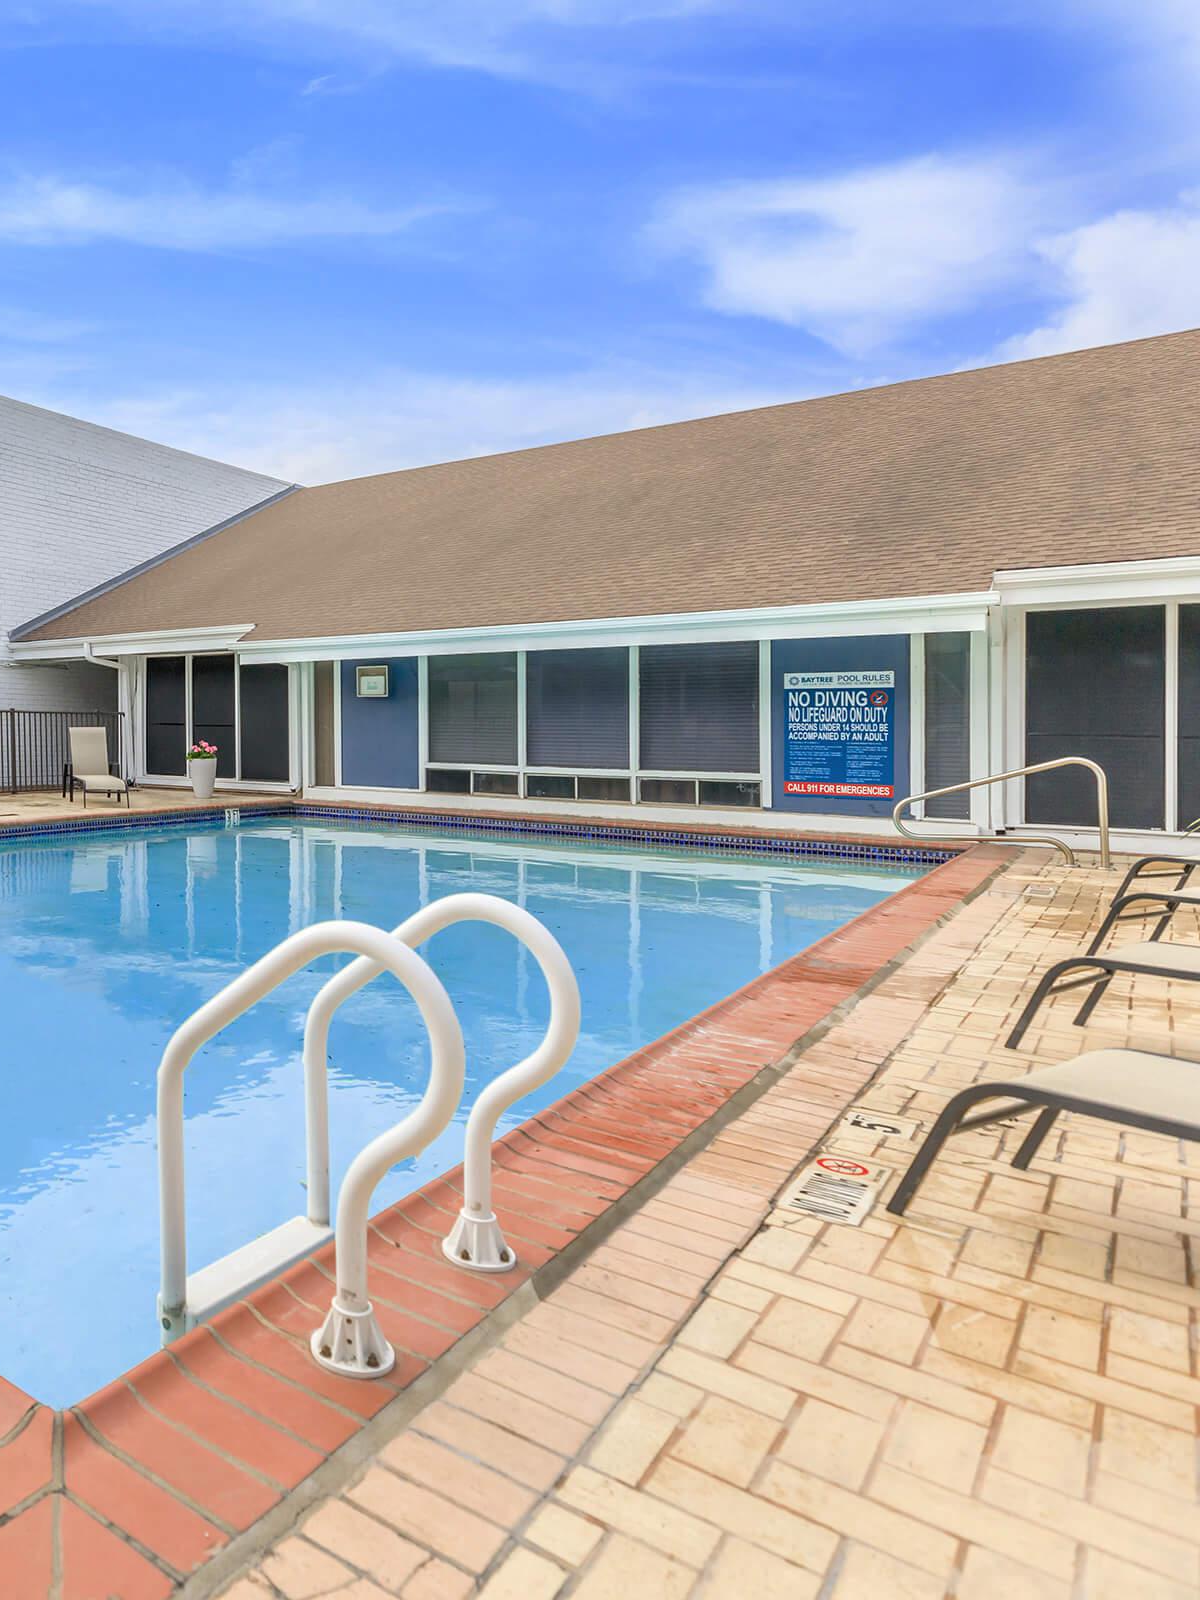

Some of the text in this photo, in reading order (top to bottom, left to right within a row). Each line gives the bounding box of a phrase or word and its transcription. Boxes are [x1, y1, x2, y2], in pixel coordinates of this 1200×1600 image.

[862, 674, 891, 682] RULES
[788, 691, 868, 707] NO DIVING
[788, 707, 888, 723] NO LIFEGUARD ON DUTY
[788, 723, 889, 732] PERSONS UNDER 14 SHOULD BE
[788, 732, 889, 742] ACCOMPANIED BY AN ADULT
[787, 783, 890, 796] CALL 911 FOR EMERGENCIES
[850, 1119, 903, 1135] 5
